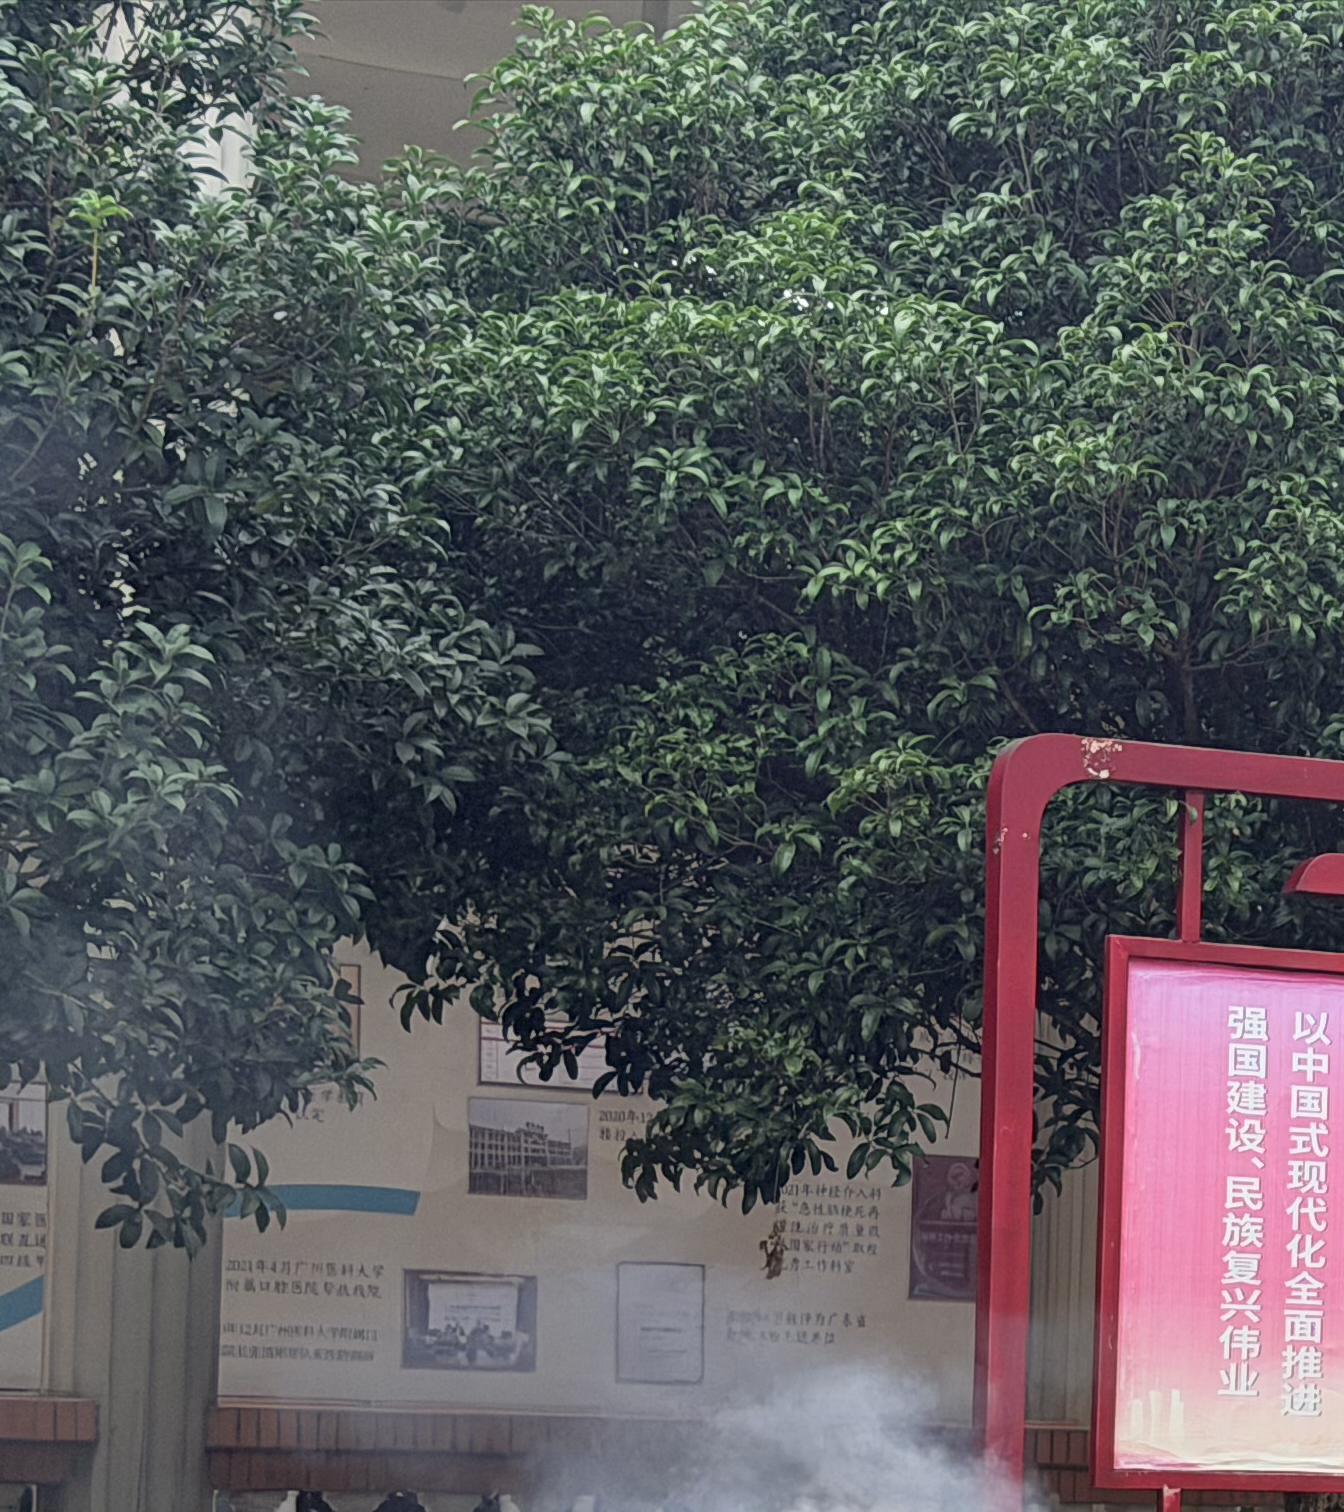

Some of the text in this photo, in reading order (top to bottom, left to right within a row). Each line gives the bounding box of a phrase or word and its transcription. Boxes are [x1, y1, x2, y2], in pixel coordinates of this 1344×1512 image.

[1217, 1004, 1270, 1400] 强国建设、民族复兴伟业
[1281, 1009, 1332, 1418] 以中国式现代化全面推进
